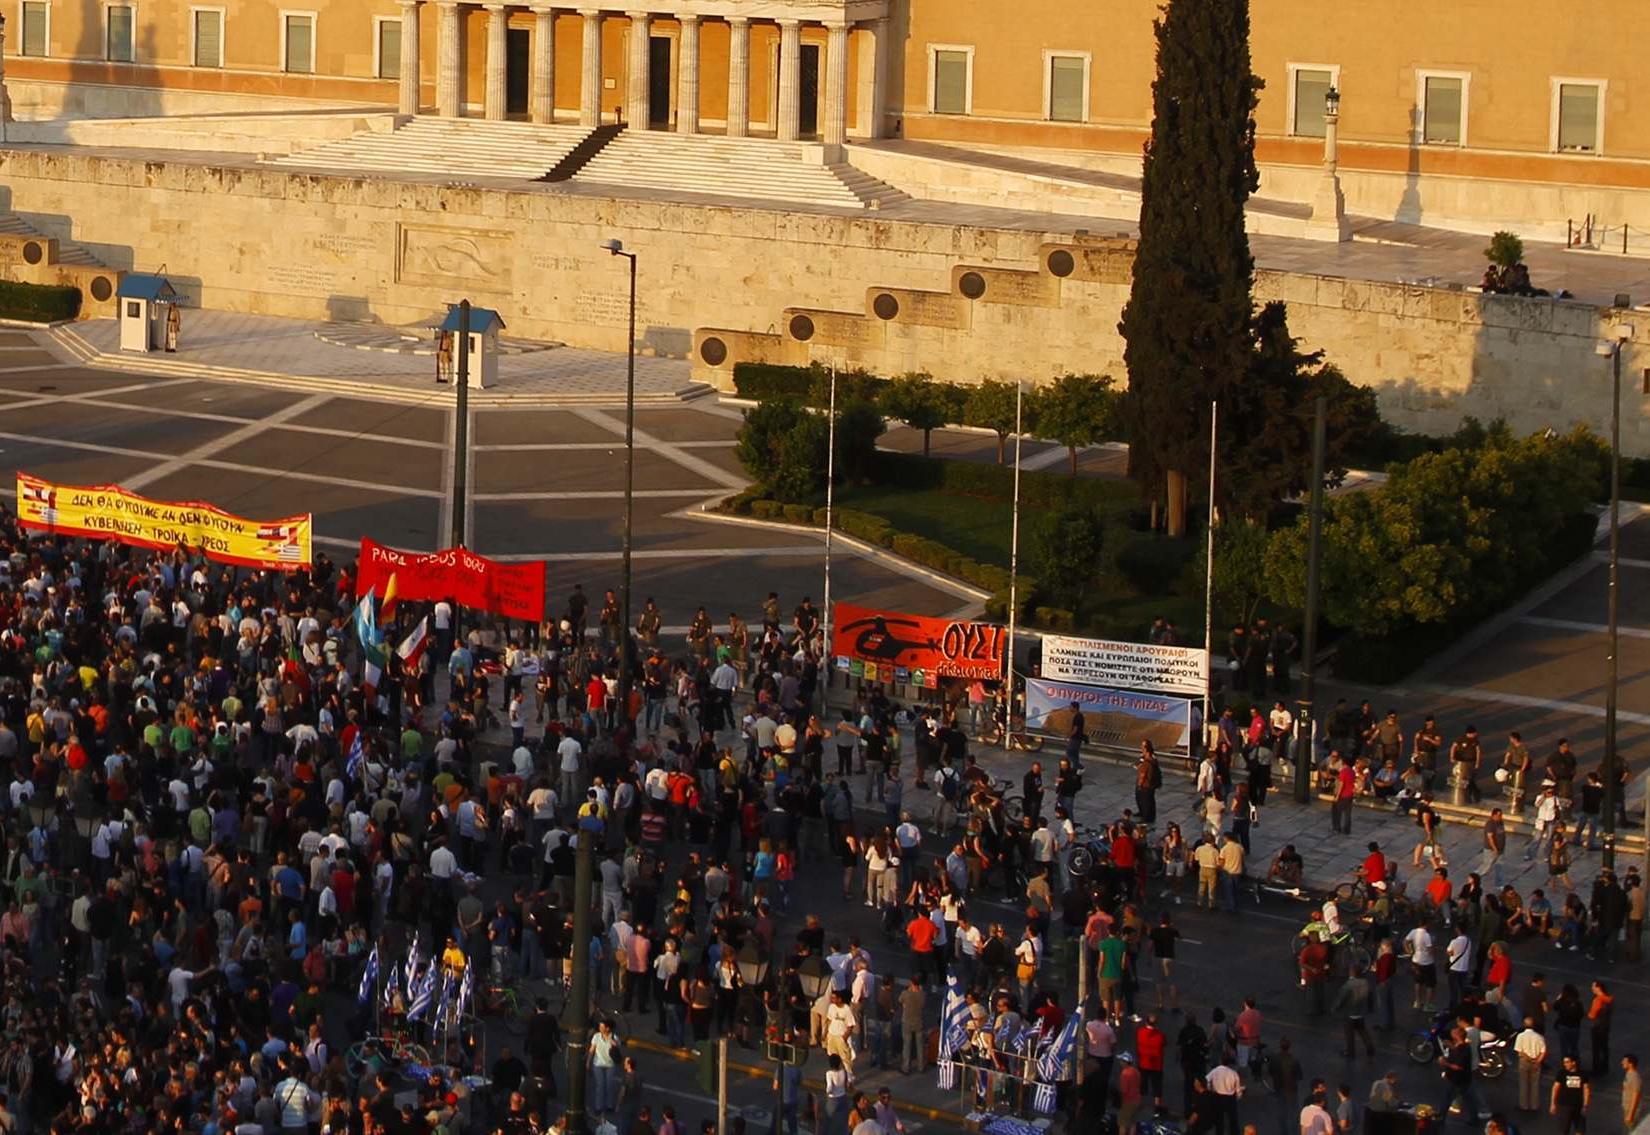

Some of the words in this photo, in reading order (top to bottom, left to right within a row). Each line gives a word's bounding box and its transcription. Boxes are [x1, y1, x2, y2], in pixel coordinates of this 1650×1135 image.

[71, 495, 94, 507] ΔΕΝ
[97, 497, 113, 508] ΘΑ
[162, 510, 175, 521] ΑΝ
[179, 511, 200, 524] ΔΕΝ
[1090, 652, 1104, 660] ΚΑΙ
[1105, 695, 1127, 706] ΤΗΣ
